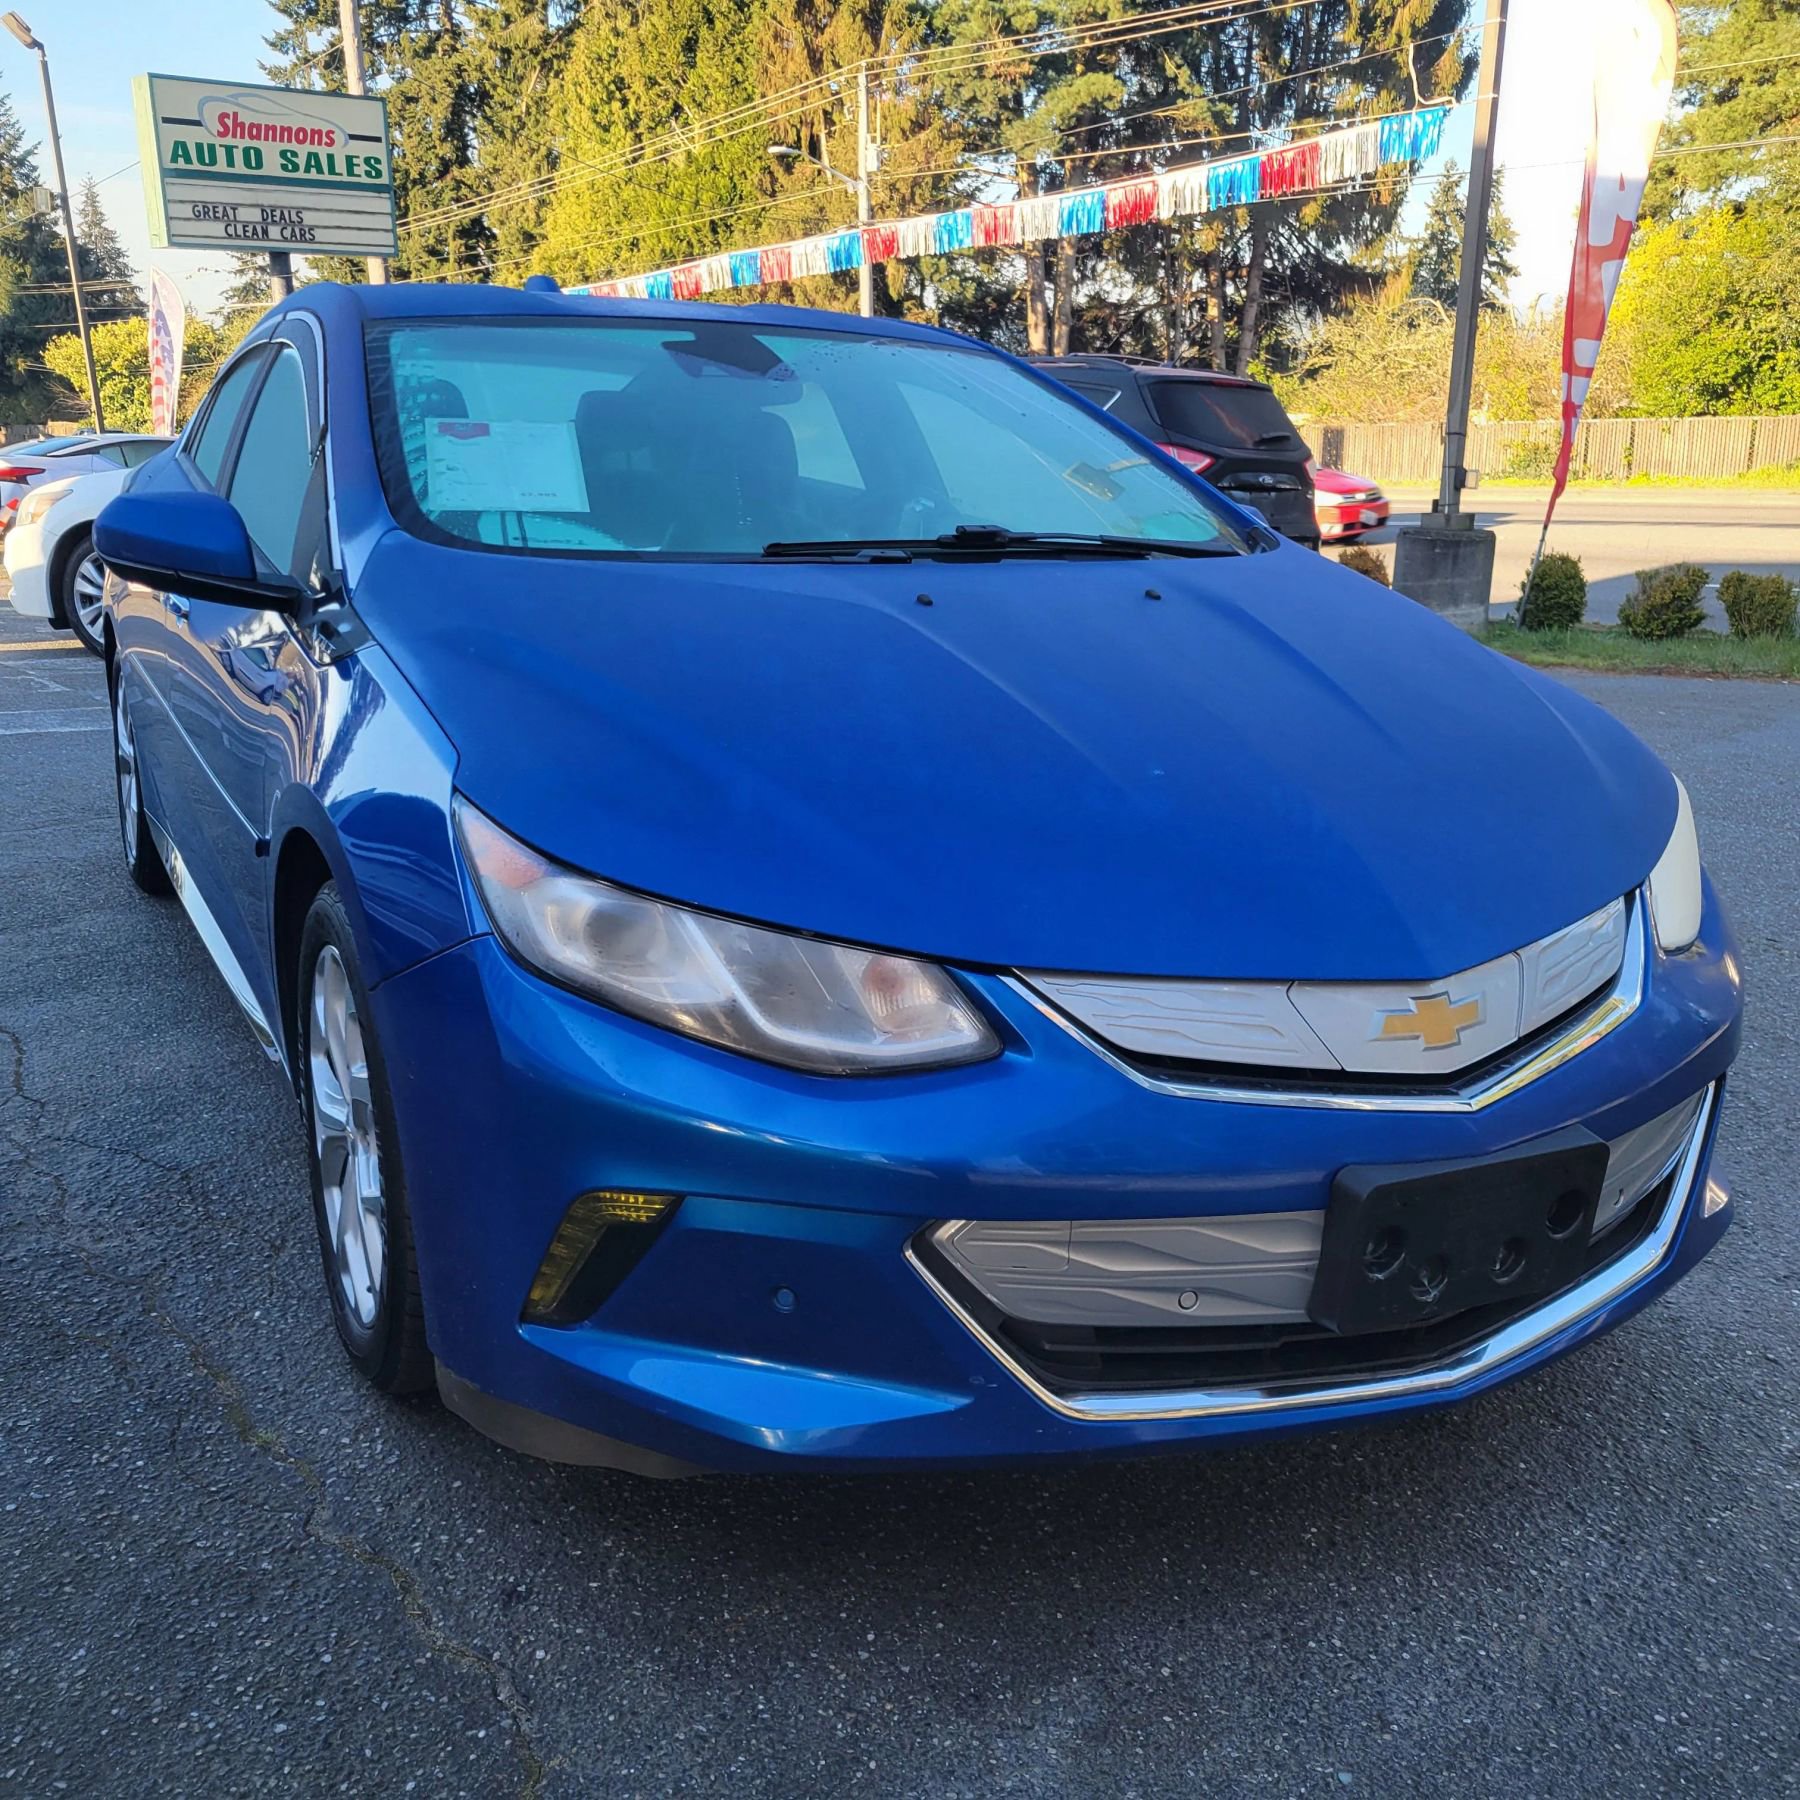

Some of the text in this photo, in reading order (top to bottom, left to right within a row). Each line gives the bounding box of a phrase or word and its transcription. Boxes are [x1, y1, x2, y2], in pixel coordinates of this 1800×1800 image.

[216, 112, 336, 148] Shannons
[169, 140, 383, 180] AUTO SALES
[191, 204, 304, 224] GREAT DEALS
[224, 223, 316, 242] CLEAN CARS
